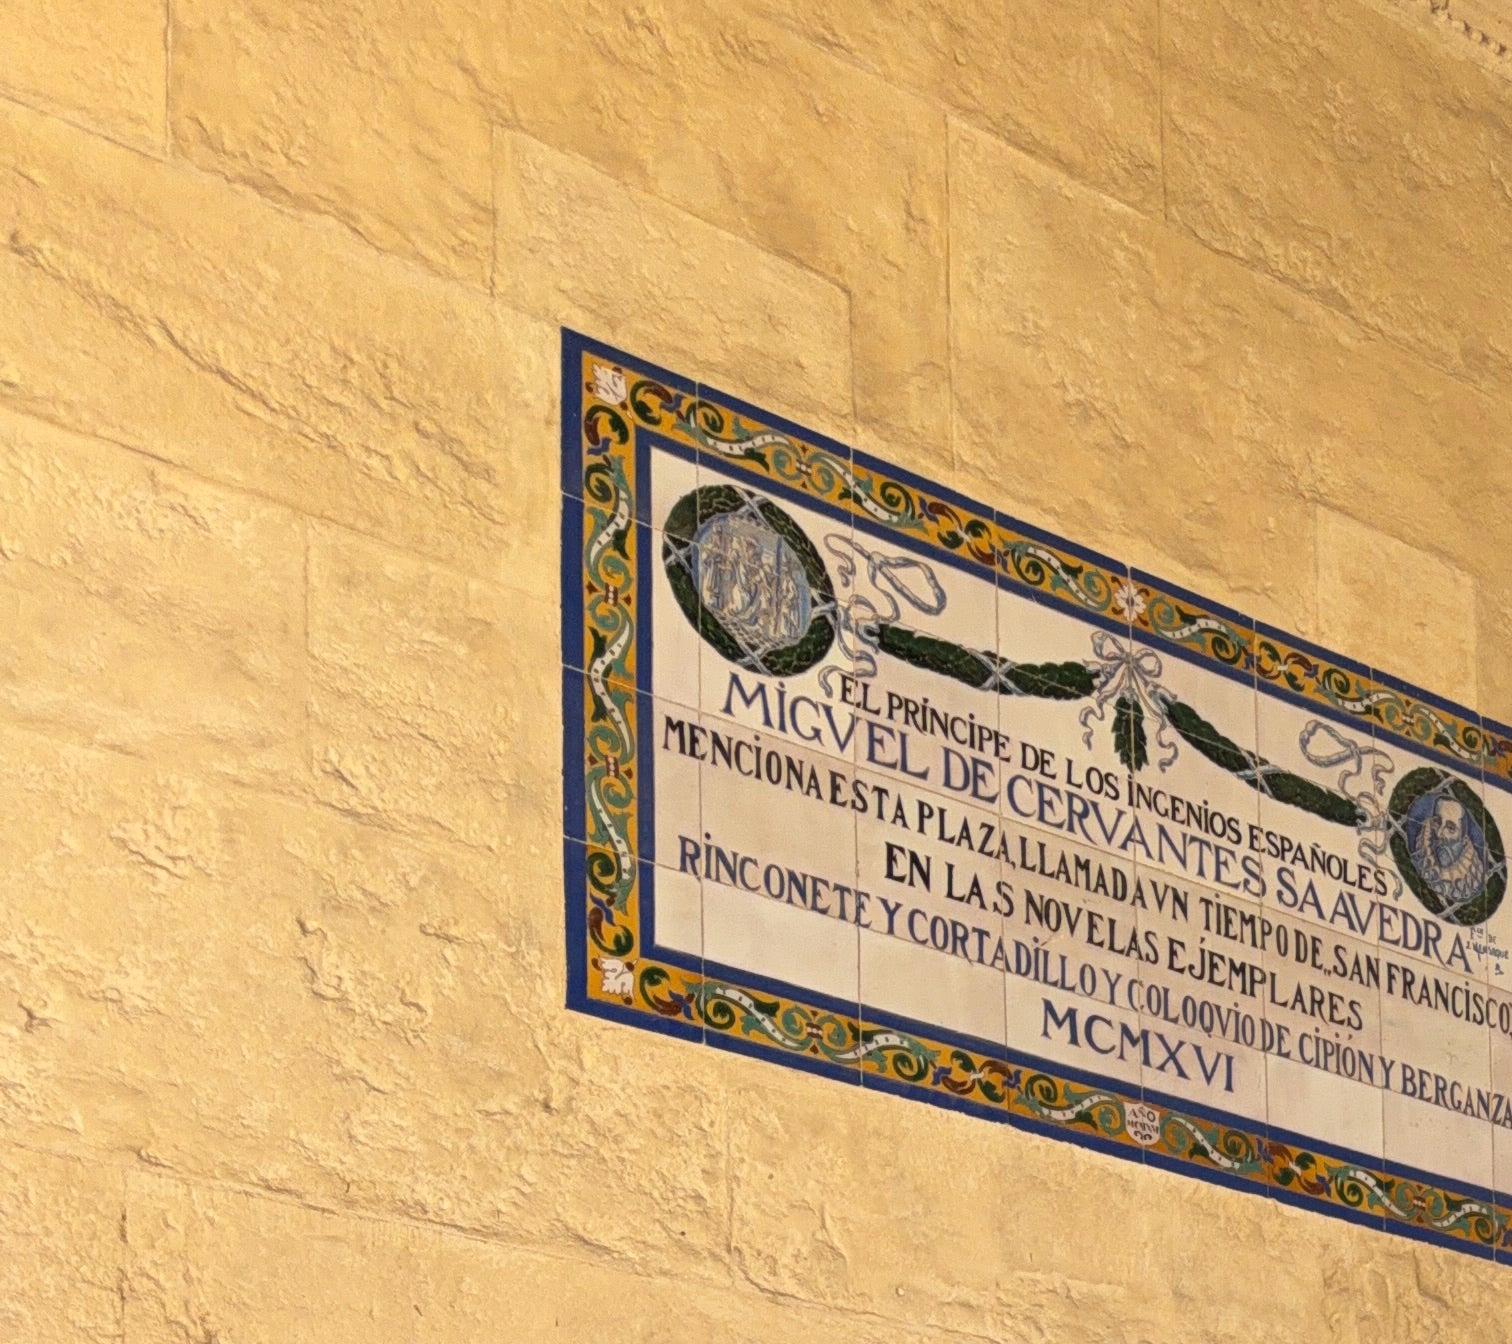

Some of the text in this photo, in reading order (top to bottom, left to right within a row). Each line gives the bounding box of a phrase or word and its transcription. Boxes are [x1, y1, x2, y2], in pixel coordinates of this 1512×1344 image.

[662, 713, 825, 801] MENCIONA
[828, 768, 912, 830] ESTA
[916, 798, 1017, 870] PLAZA,
[1019, 835, 1148, 911] LLAMADA
[1199, 892, 1289, 958] TIEMPO
[1294, 928, 1324, 971] DE
[838, 672, 882, 716] EL
[1020, 740, 1057, 780] DE
[1065, 757, 1120, 801] LOS
[1126, 774, 1243, 845] INGENIOS
[1247, 822, 1388, 897] ESPAÑOLES
[941, 745, 1000, 805] DE
[1007, 773, 1267, 898] CERVANTES
[1276, 865, 1475, 975] SAAVEDRA
[677, 831, 873, 929] RINCONETE
[875, 894, 904, 936] Y
[907, 907, 1097, 997] CORTADILLO
[1100, 966, 1124, 1006] Y
[1259, 1017, 1292, 1060] DE
[1378, 1054, 1396, 1090] Y
[884, 840, 1364, 1032] EN LAS NOVELAS EJEMPLARES
[1040, 996, 1235, 1094] MCMXVI
[1127, 1105, 1157, 1123] AÑO
